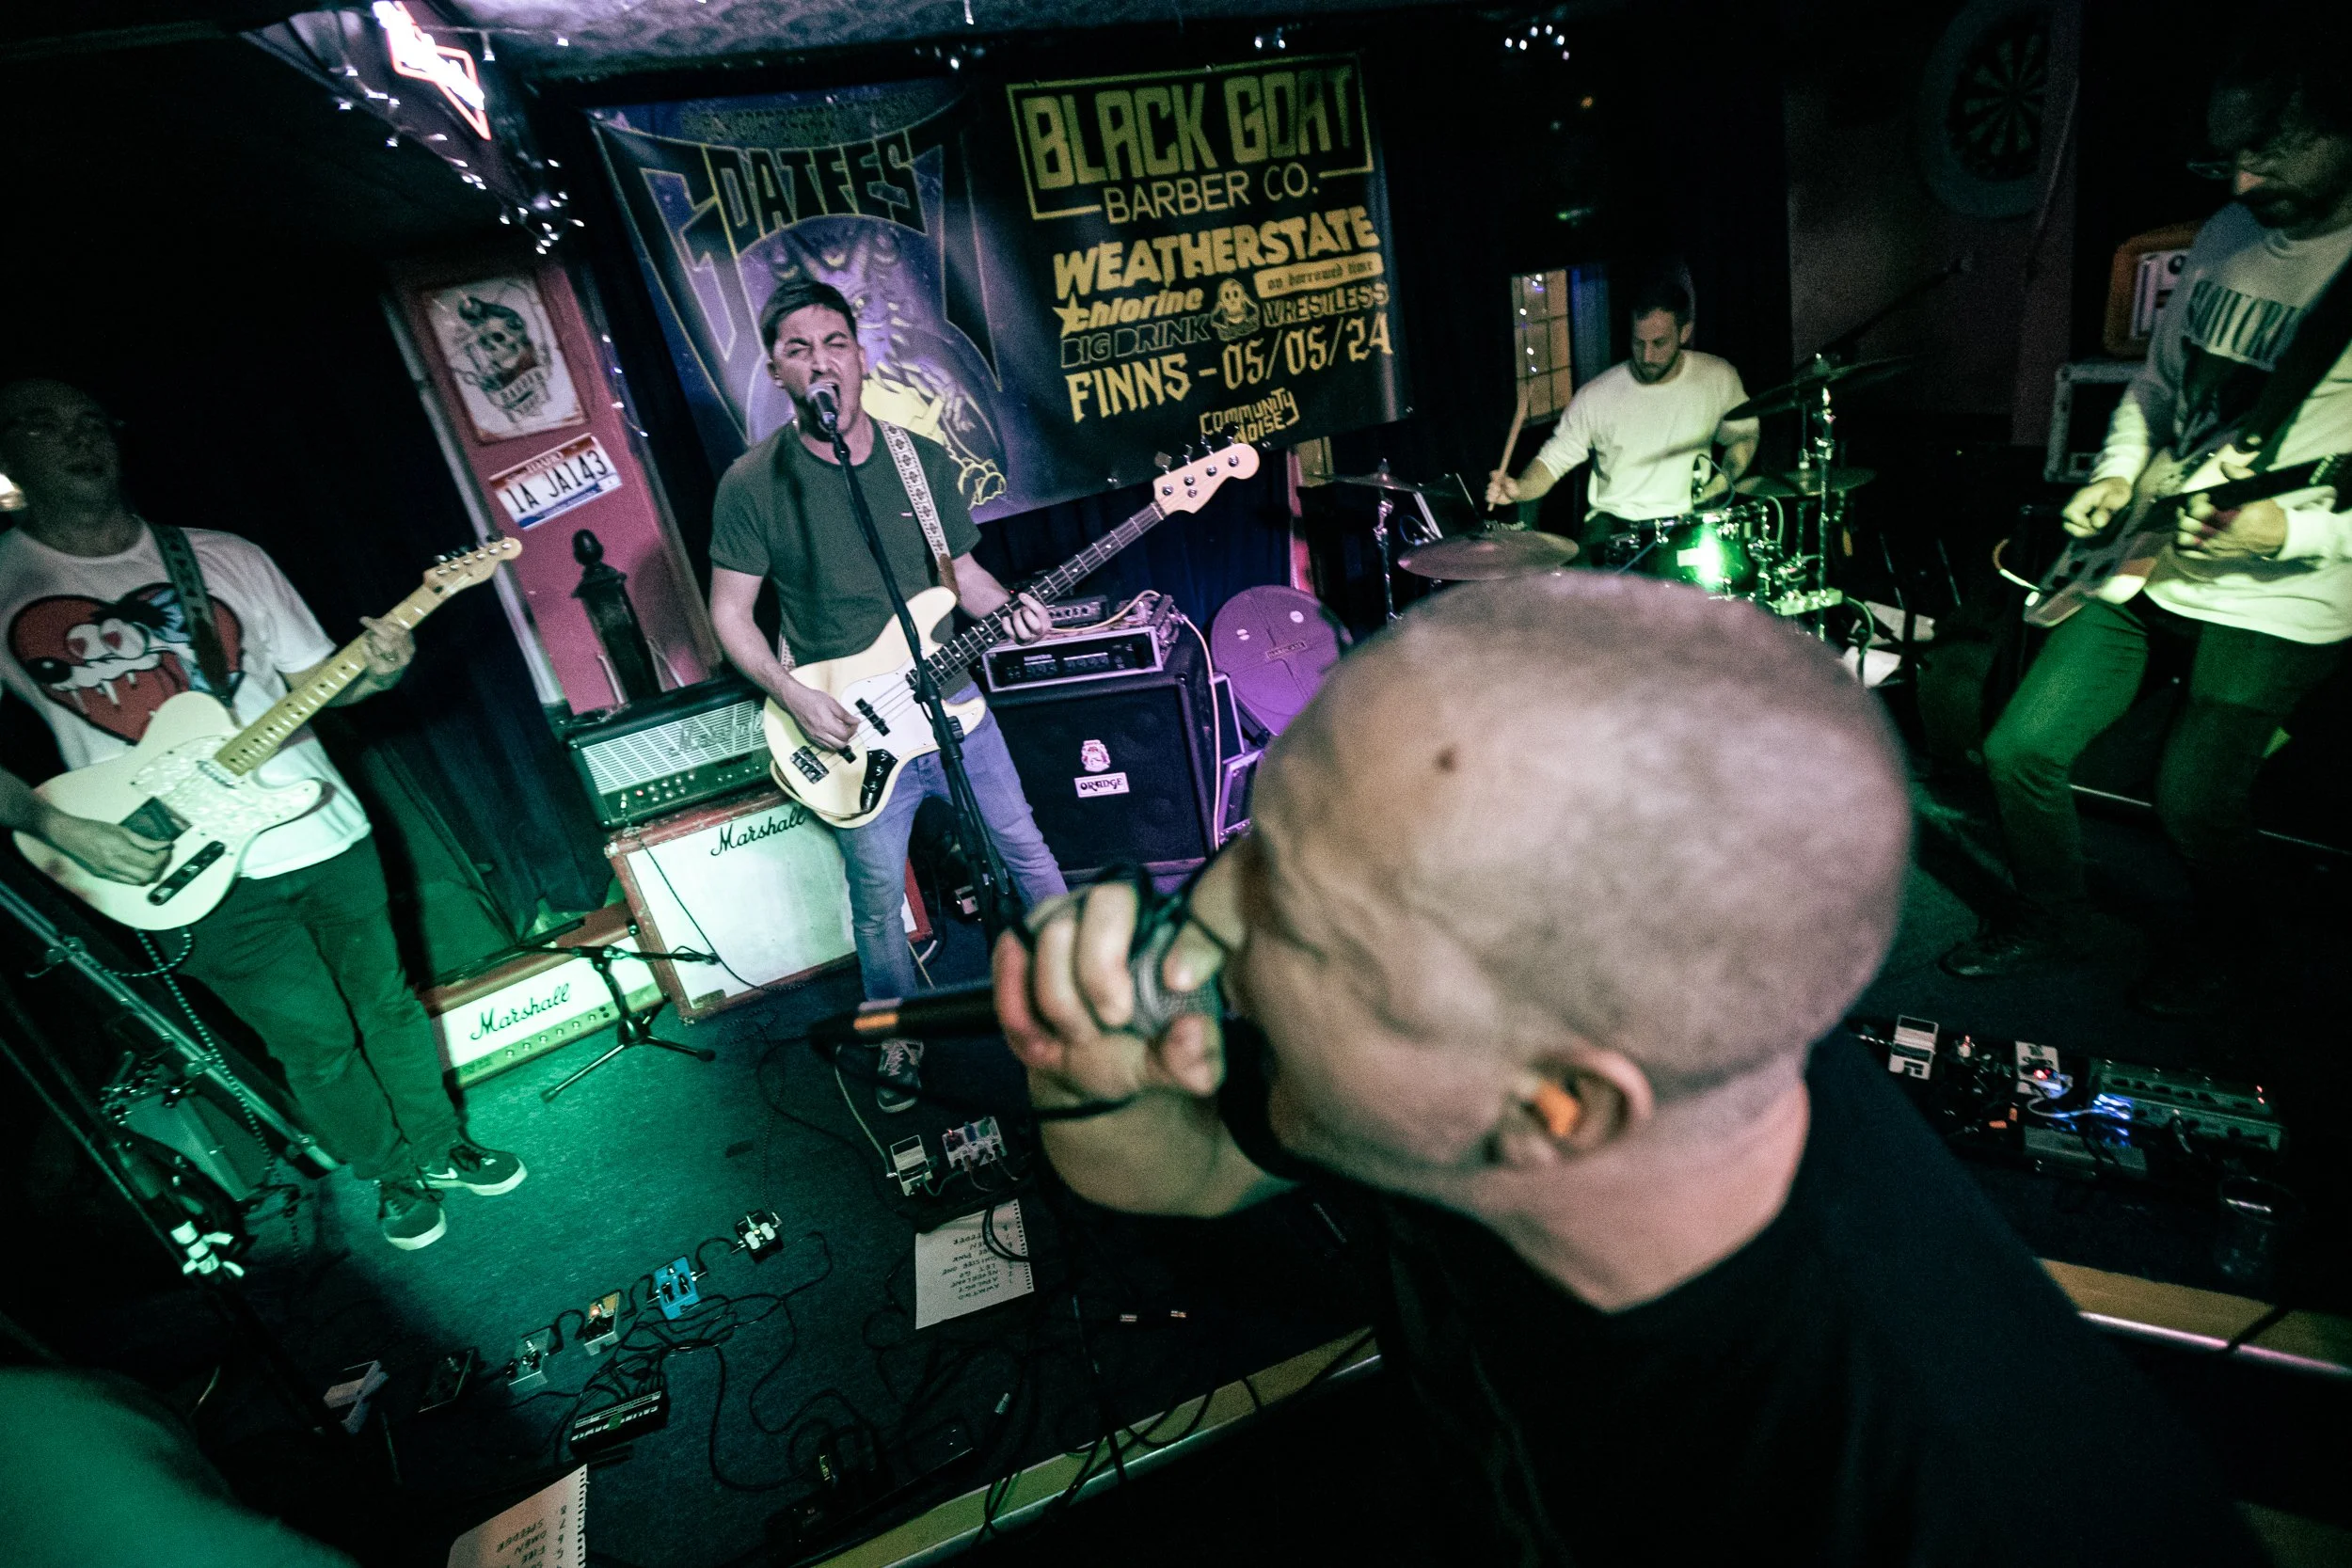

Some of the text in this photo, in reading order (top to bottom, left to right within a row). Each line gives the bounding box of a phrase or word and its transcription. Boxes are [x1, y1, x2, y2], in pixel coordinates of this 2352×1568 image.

[1022, 82, 1218, 190] BLACK
[1224, 65, 1353, 166] GOAT
[1104, 162, 1319, 225] BARBER CO.
[1053, 205, 1379, 299] WEATHERSTATE
[1071, 287, 1204, 332] chlorine
[1061, 333, 1112, 368] BIG
[1115, 313, 1211, 357] DRINK
[1065, 353, 1192, 422] FINNS
[1222, 312, 1393, 389] 05/05/24
[668, 711, 766, 758] Marshal
[1080, 776, 1123, 793] ORANGE
[710, 809, 805, 856] Marshall
[469, 983, 571, 1040] Marshall
